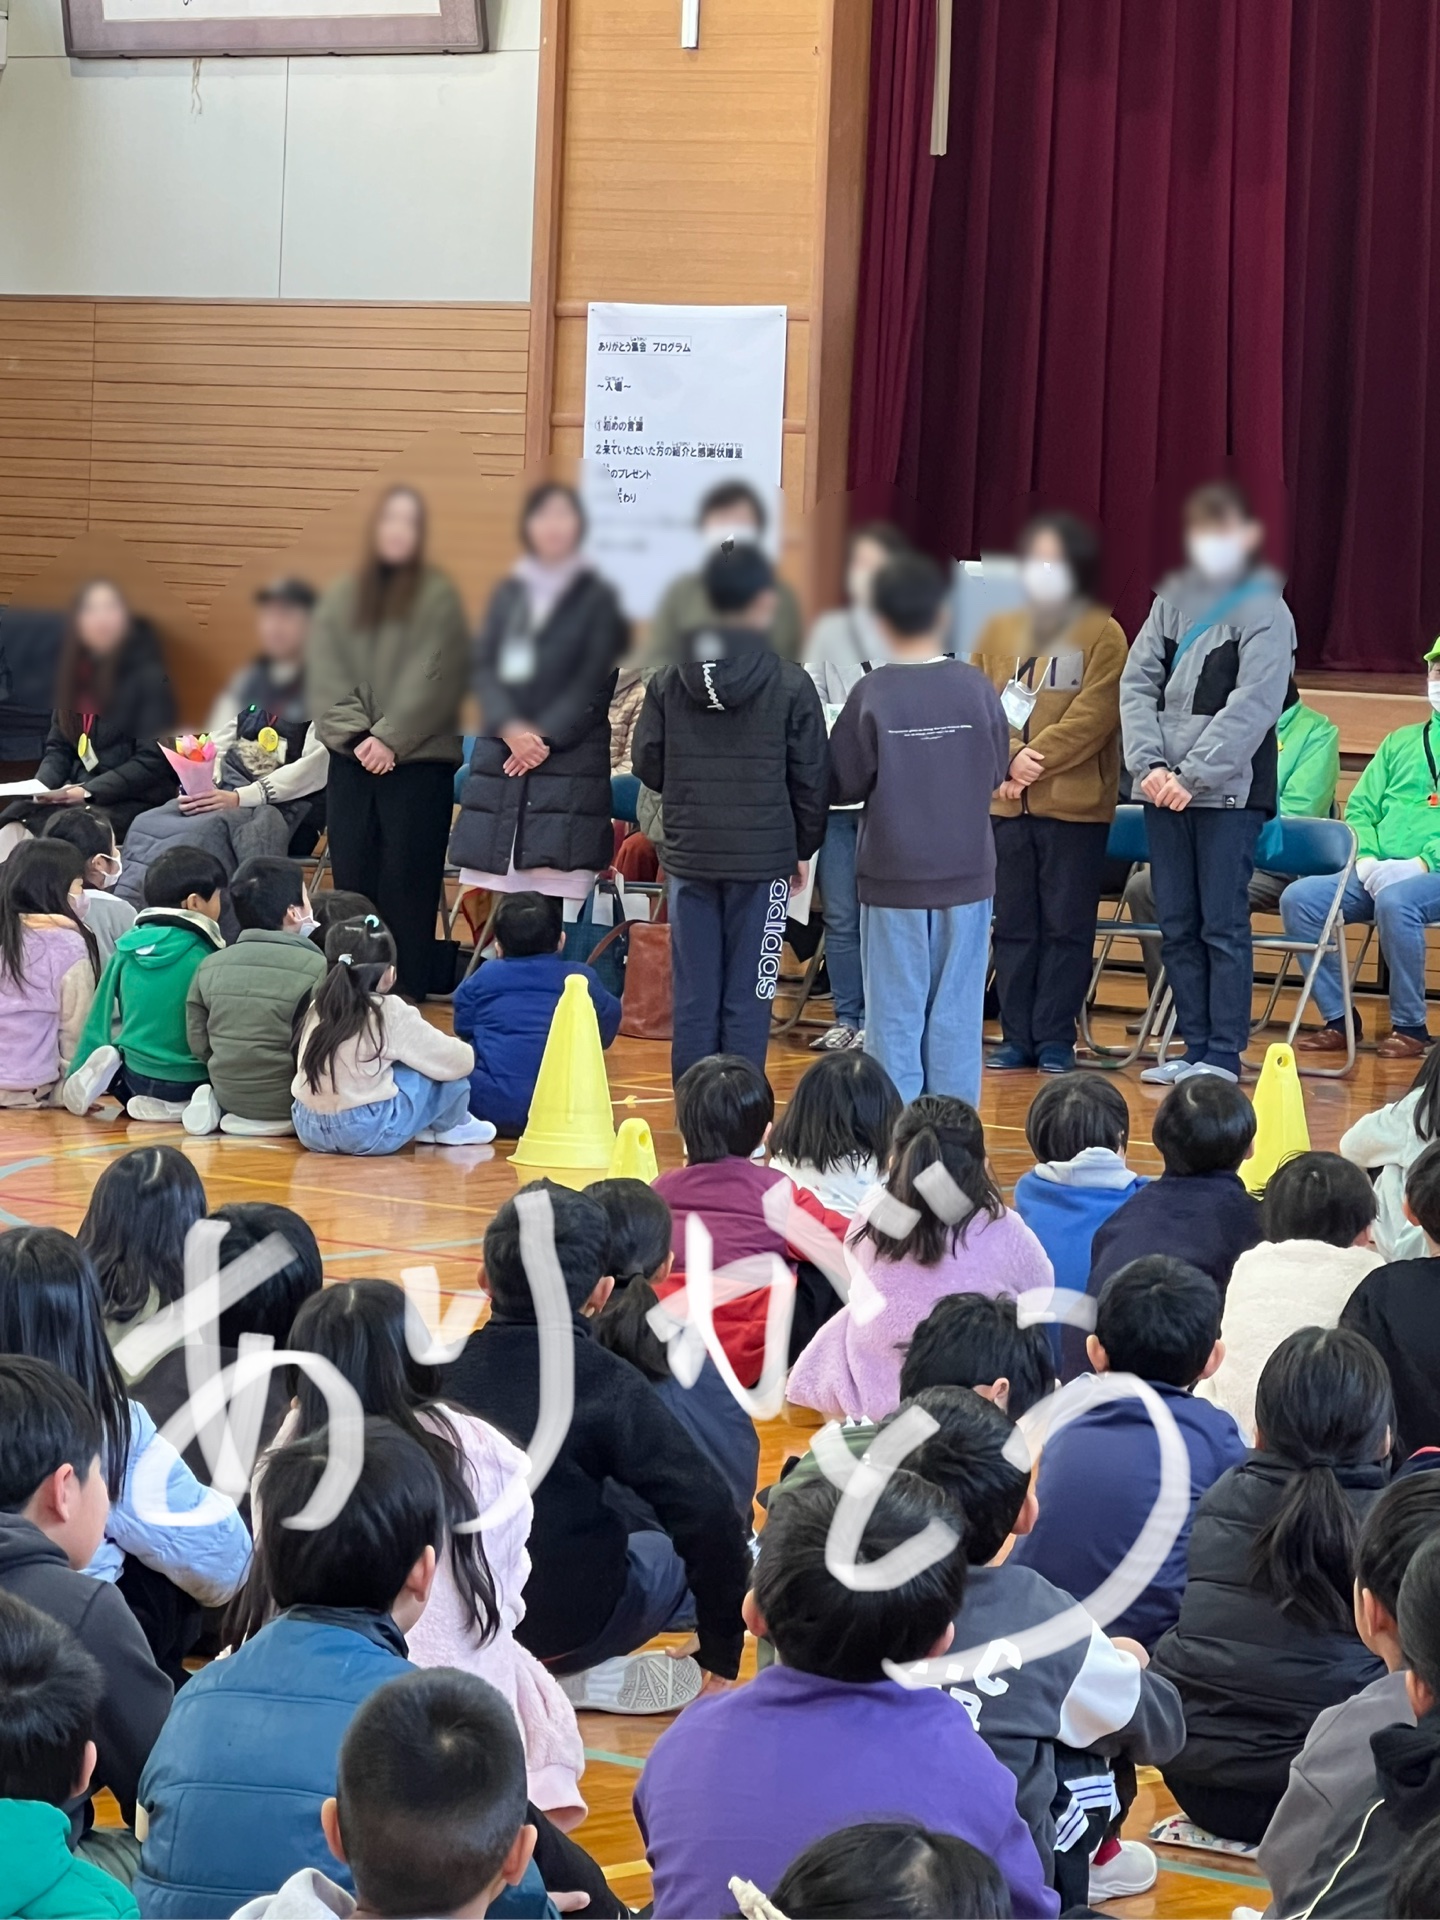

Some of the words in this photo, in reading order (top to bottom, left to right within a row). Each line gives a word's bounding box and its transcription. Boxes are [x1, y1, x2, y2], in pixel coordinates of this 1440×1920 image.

[652, 342, 691, 353] プログラム
[607, 469, 651, 479] のプレゼント
[755, 878, 789, 1000] adidas
